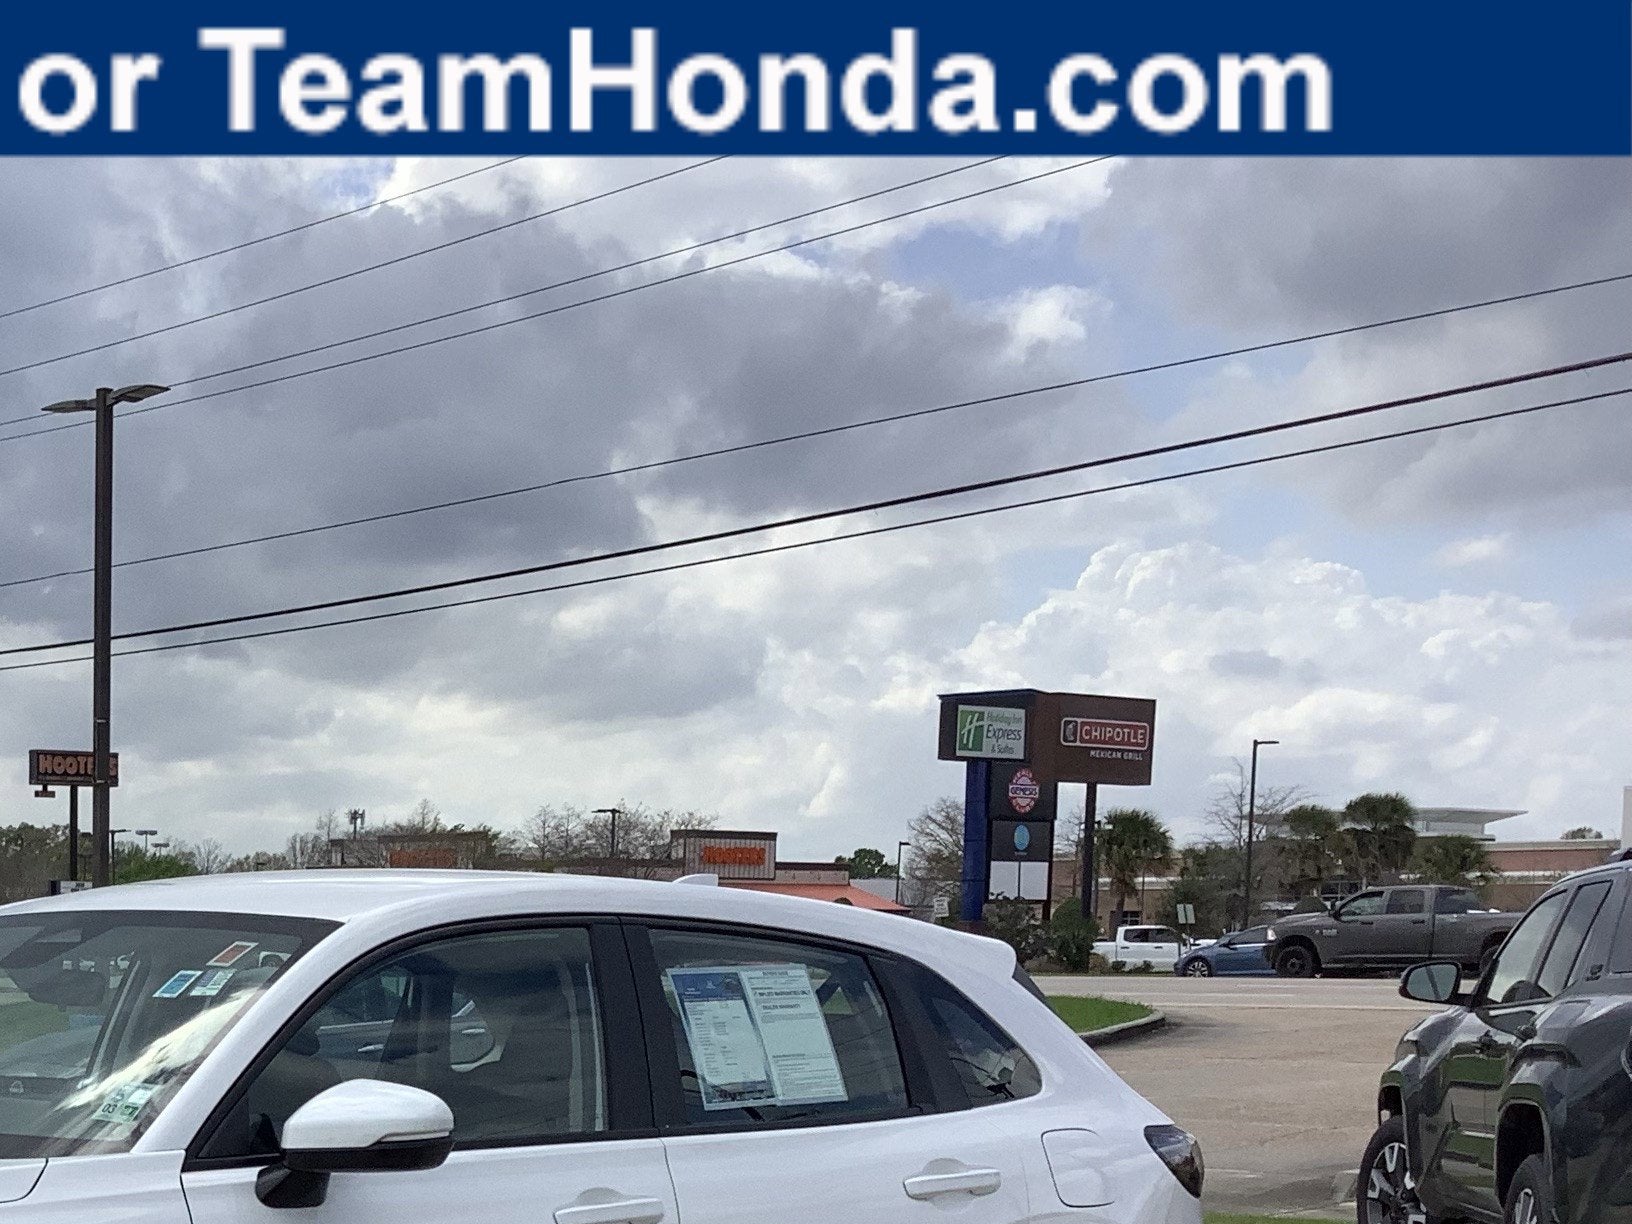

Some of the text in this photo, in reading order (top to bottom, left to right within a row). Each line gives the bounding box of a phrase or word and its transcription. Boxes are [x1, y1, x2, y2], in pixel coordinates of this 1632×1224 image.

[986, 723, 1023, 743] Express
[1081, 725, 1145, 744] CHIPOTLE
[1089, 750, 1143, 760] MEXICAN GRILL
[38, 754, 118, 776] HOOTES
